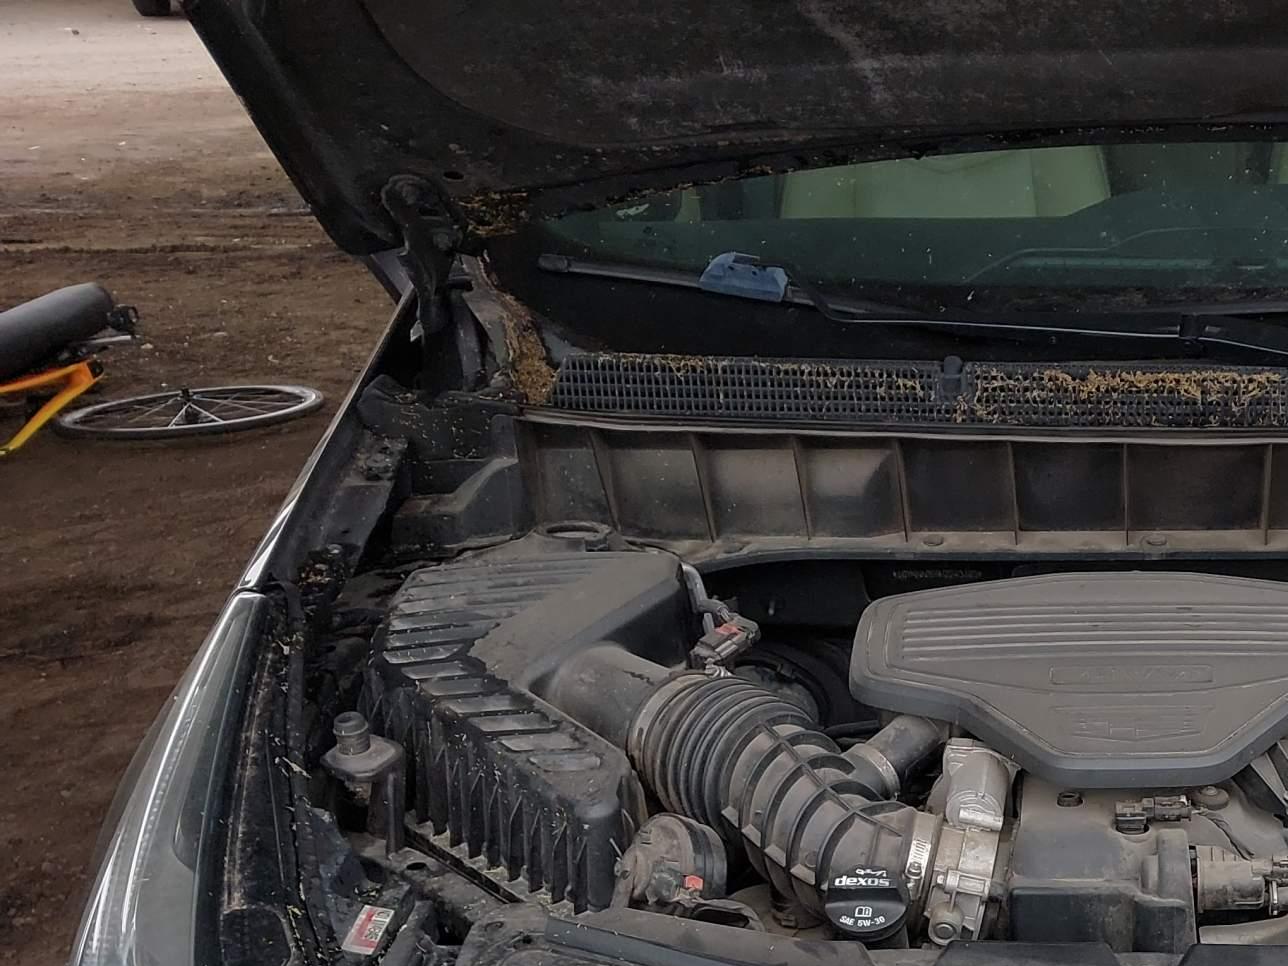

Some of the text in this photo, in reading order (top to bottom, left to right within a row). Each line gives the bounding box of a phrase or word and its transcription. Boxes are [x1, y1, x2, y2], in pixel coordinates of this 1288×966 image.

[834, 875, 890, 887] dexos
[839, 915, 886, 927] SAE 5W-30
